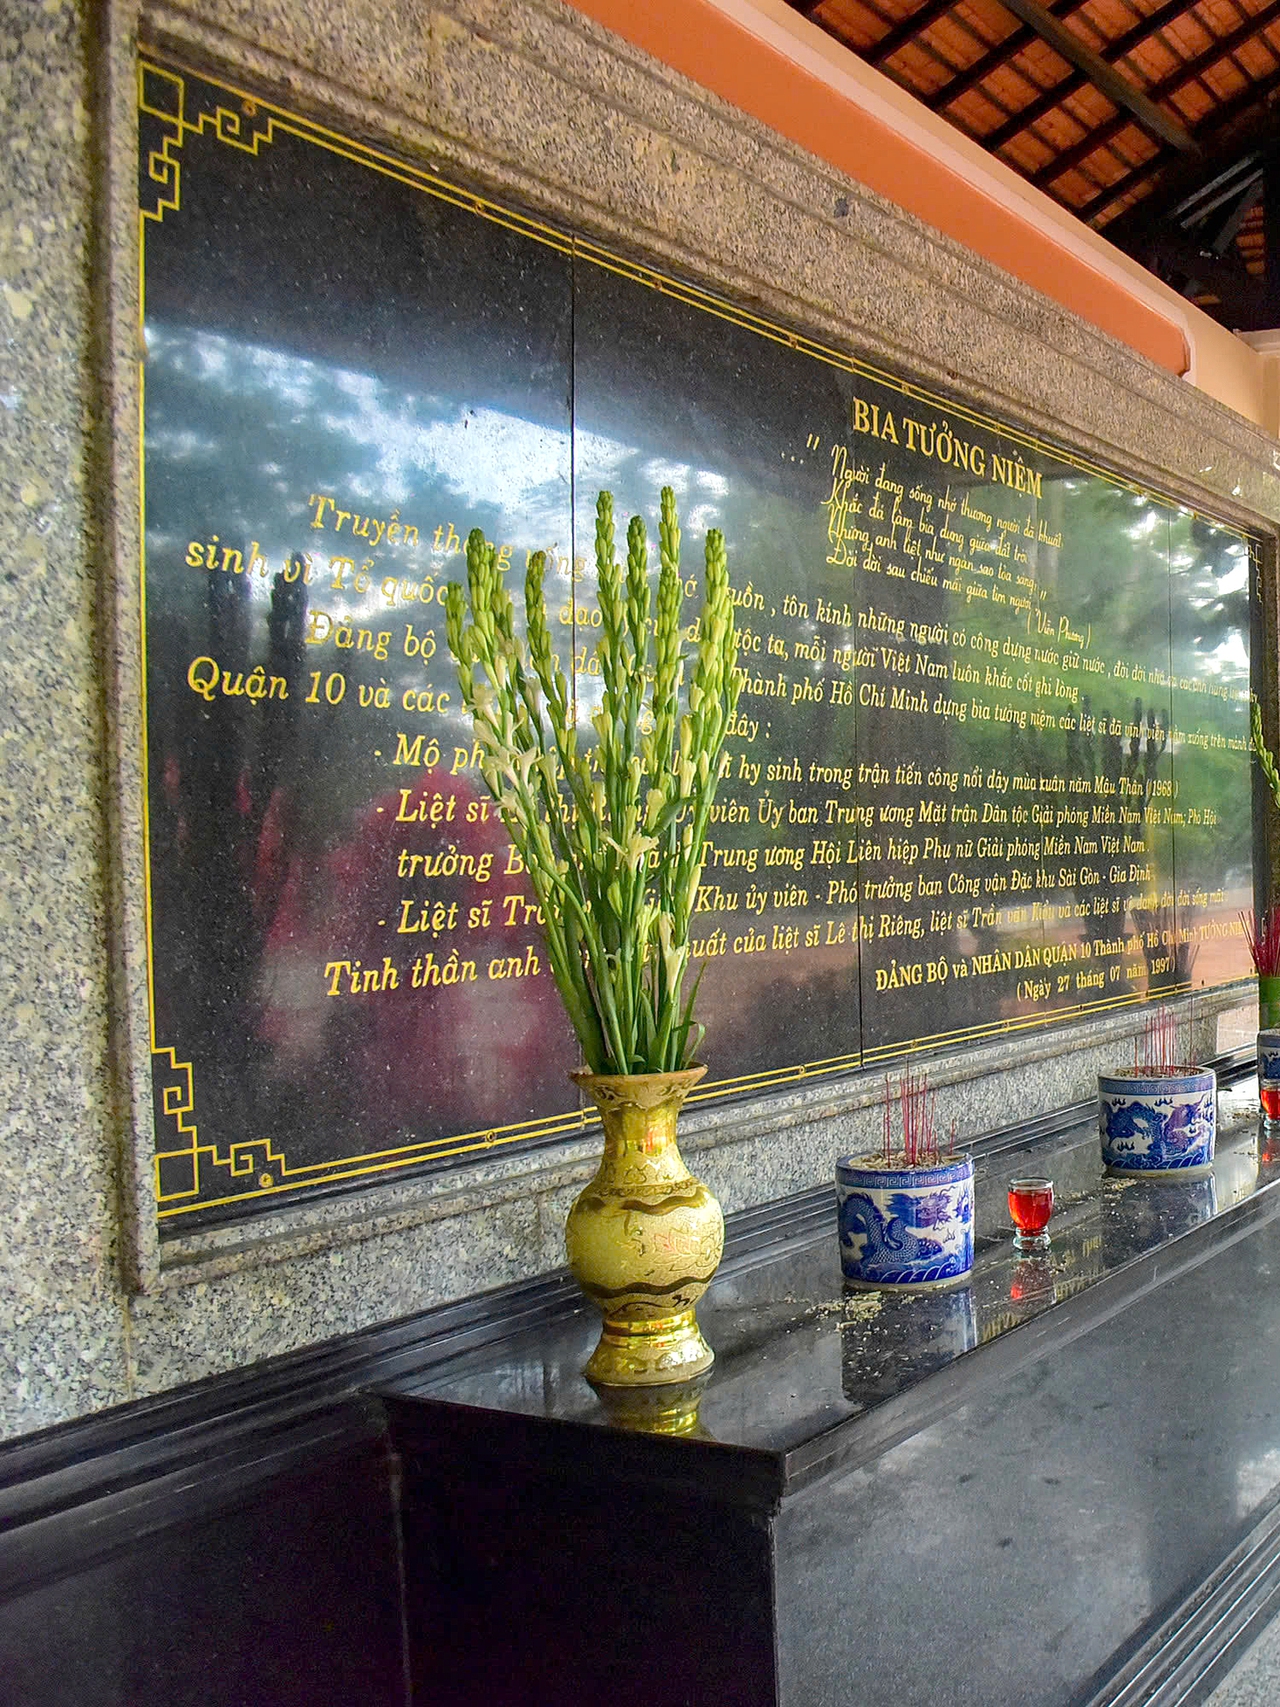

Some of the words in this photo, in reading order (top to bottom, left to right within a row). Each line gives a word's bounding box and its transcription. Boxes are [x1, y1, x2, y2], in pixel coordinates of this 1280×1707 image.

[853, 397, 900, 445] BIA
[903, 420, 985, 477] TƯỞNG
[991, 454, 1042, 499] NIỆM
[821, 477, 863, 514] Khắc
[874, 462, 904, 502] đang
[909, 485, 933, 512] sống
[938, 485, 957, 512] nhớ
[826, 539, 858, 567] Đời
[863, 542, 882, 573] đời
[886, 563, 906, 579] sau
[911, 556, 938, 587] chiếu
[943, 577, 962, 592] mãi
[992, 583, 1006, 604] tim
[903, 527, 921, 560] liệt
[925, 536, 945, 563] như
[979, 564, 994, 577] sao
[185, 535, 267, 577] sinh
[283, 553, 314, 585] vì
[329, 555, 375, 593] Tổ
[382, 572, 448, 606] quốc
[559, 601, 602, 635] đạo
[767, 635, 789, 661] ta,
[794, 635, 827, 663] mỗi
[881, 647, 911, 676] Việt
[915, 654, 949, 679] Nam
[952, 660, 980, 684] luôn
[984, 666, 1013, 689] khắc
[1017, 673, 1033, 692] cốt
[1035, 676, 1052, 698] ghi
[308, 494, 419, 547] Truyền
[783, 595, 809, 619] tôn
[816, 599, 853, 627] kính
[857, 607, 905, 639] những
[910, 621, 949, 644] người
[953, 628, 966, 647] có
[970, 632, 999, 657] công
[1003, 637, 1031, 665] dựng
[1034, 647, 1059, 665] nước
[1062, 651, 1080, 671] giữ
[1114, 660, 1129, 679] đời
[1132, 663, 1146, 682] đời
[187, 656, 290, 705] Quận
[304, 671, 347, 705] 10
[358, 677, 391, 709] và
[402, 683, 450, 713] các
[304, 610, 391, 661] Đảng
[403, 624, 436, 666] bộ
[791, 677, 826, 706] phố
[830, 680, 854, 706] Hồ
[859, 683, 886, 708] Chí
[890, 686, 929, 713] Minh
[933, 693, 967, 722] dựng
[971, 698, 990, 720] bia
[994, 703, 1027, 729] tưởng
[1030, 708, 1056, 731] niệm
[1059, 712, 1076, 731] các
[1079, 713, 1096, 737] liệt
[1098, 720, 1107, 735] sĩ
[1109, 718, 1122, 736] đã
[1147, 724, 1165, 741] viễn
[1210, 733, 1226, 748] trên
[393, 733, 441, 774] Mộ
[739, 755, 761, 786] hy
[767, 757, 803, 782] sinh
[809, 761, 853, 790] trong
[858, 762, 890, 788] trận
[894, 760, 922, 786] tiến
[927, 772, 959, 792] công
[963, 765, 983, 788] nổi
[987, 769, 1009, 794] dậy
[1013, 772, 1037, 791] mùa
[1039, 776, 1065, 793] xuân
[1068, 777, 1091, 793] năm
[1094, 776, 1116, 799] Mậu
[1119, 776, 1144, 796] Thân
[395, 789, 457, 829] Liệt
[465, 795, 491, 824] sĩ
[709, 799, 750, 824] viên
[758, 789, 786, 830] Ủy
[788, 799, 819, 825] ban
[825, 800, 874, 828] Trung
[879, 804, 914, 828] ương
[918, 800, 947, 827] Mặt
[951, 805, 978, 827] trận
[982, 802, 1007, 823] Dân
[1012, 805, 1028, 827] tộc
[1032, 804, 1054, 826] Giải
[1057, 804, 1089, 828] phóng
[1092, 803, 1115, 823] Miền
[1118, 809, 1141, 824] Nam
[1144, 807, 1161, 828] Việt
[397, 845, 494, 882] trưởng
[699, 841, 758, 872] Trung
[765, 846, 805, 871] ương
[811, 840, 842, 869] Hội
[847, 839, 882, 864] Liên
[887, 837, 919, 865] hiệp
[923, 837, 951, 863] Phụ
[956, 840, 973, 859] nữ
[977, 837, 1004, 859] Giải
[1006, 836, 1040, 862] phóng
[1043, 835, 1071, 856] Miền
[1074, 838, 1098, 855] Nam
[1100, 835, 1120, 858] Việt
[397, 900, 459, 938] Liệt
[467, 900, 491, 929] sĩ
[694, 886, 738, 913] Khu
[746, 883, 768, 915] ủy
[773, 883, 808, 908] viên
[826, 880, 857, 905] Phó
[864, 876, 913, 902] trưởng
[917, 875, 942, 897] ban
[948, 873, 981, 898] Công
[985, 873, 1007, 896] vận
[1010, 869, 1032, 892] Đặc
[1036, 869, 1055, 888] khu
[1059, 867, 1077, 887] Sài
[1079, 866, 1100, 885] Gòn
[1109, 865, 1127, 884] Gia
[324, 957, 399, 996] Tinh
[411, 949, 477, 988] thần
[488, 946, 541, 980] anh
[733, 927, 766, 954] của
[772, 925, 800, 954] liệt
[805, 922, 820, 947] sĩ
[825, 921, 846, 945] Lê
[851, 914, 875, 943] thị
[878, 914, 926, 940] Riêng,
[930, 910, 953, 935] liệt
[957, 909, 969, 929] sĩ
[972, 902, 1002, 928] Trần
[1058, 902, 1072, 918] và
[1074, 899, 1092, 917] các
[1093, 896, 1109, 919] liệt
[1112, 896, 1120, 913] sĩ
[876, 959, 923, 991] ĐẢNG
[927, 955, 948, 985] BỘ
[953, 959, 969, 979] và
[972, 949, 1012, 976] NHÂN
[1015, 944, 1040, 970] DÂN
[1043, 941, 1077, 968] QUẬN
[1081, 945, 1091, 959] 10
[1095, 937, 1125, 956] Thành
[1127, 935, 1144, 956] phố
[1147, 930, 1159, 949] Hồ
[1057, 975, 1070, 993] 27
[1076, 970, 1105, 990] tháng
[1110, 966, 1121, 982] 07
[1126, 964, 1148, 979] năm
